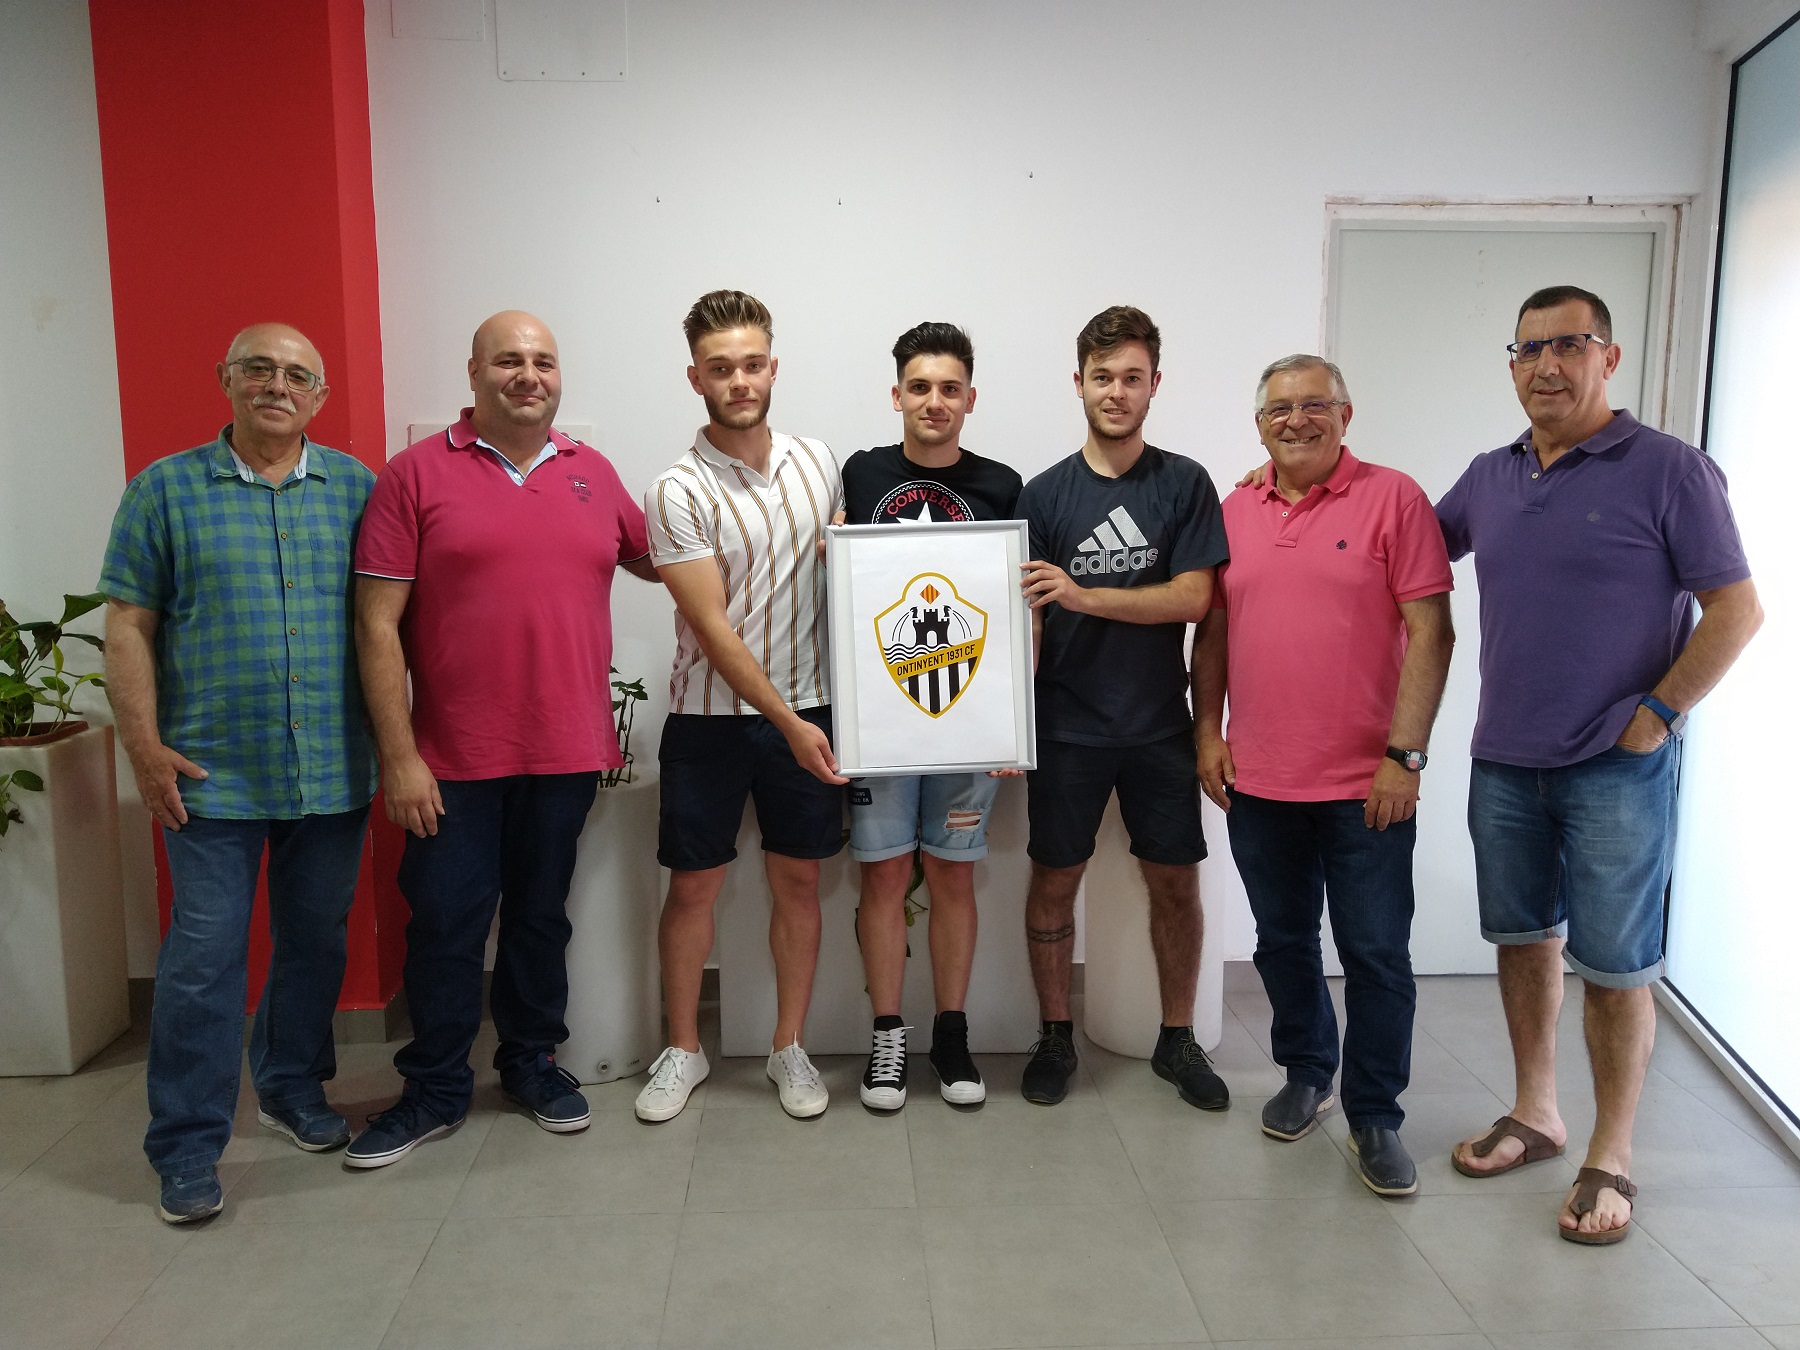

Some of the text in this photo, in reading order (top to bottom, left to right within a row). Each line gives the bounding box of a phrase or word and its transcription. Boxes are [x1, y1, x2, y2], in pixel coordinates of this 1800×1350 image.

[886, 489, 965, 522] CONVERSE
[1070, 546, 1159, 576] adidas
[897, 644, 976, 676] ONTINYENT 1931 CF
